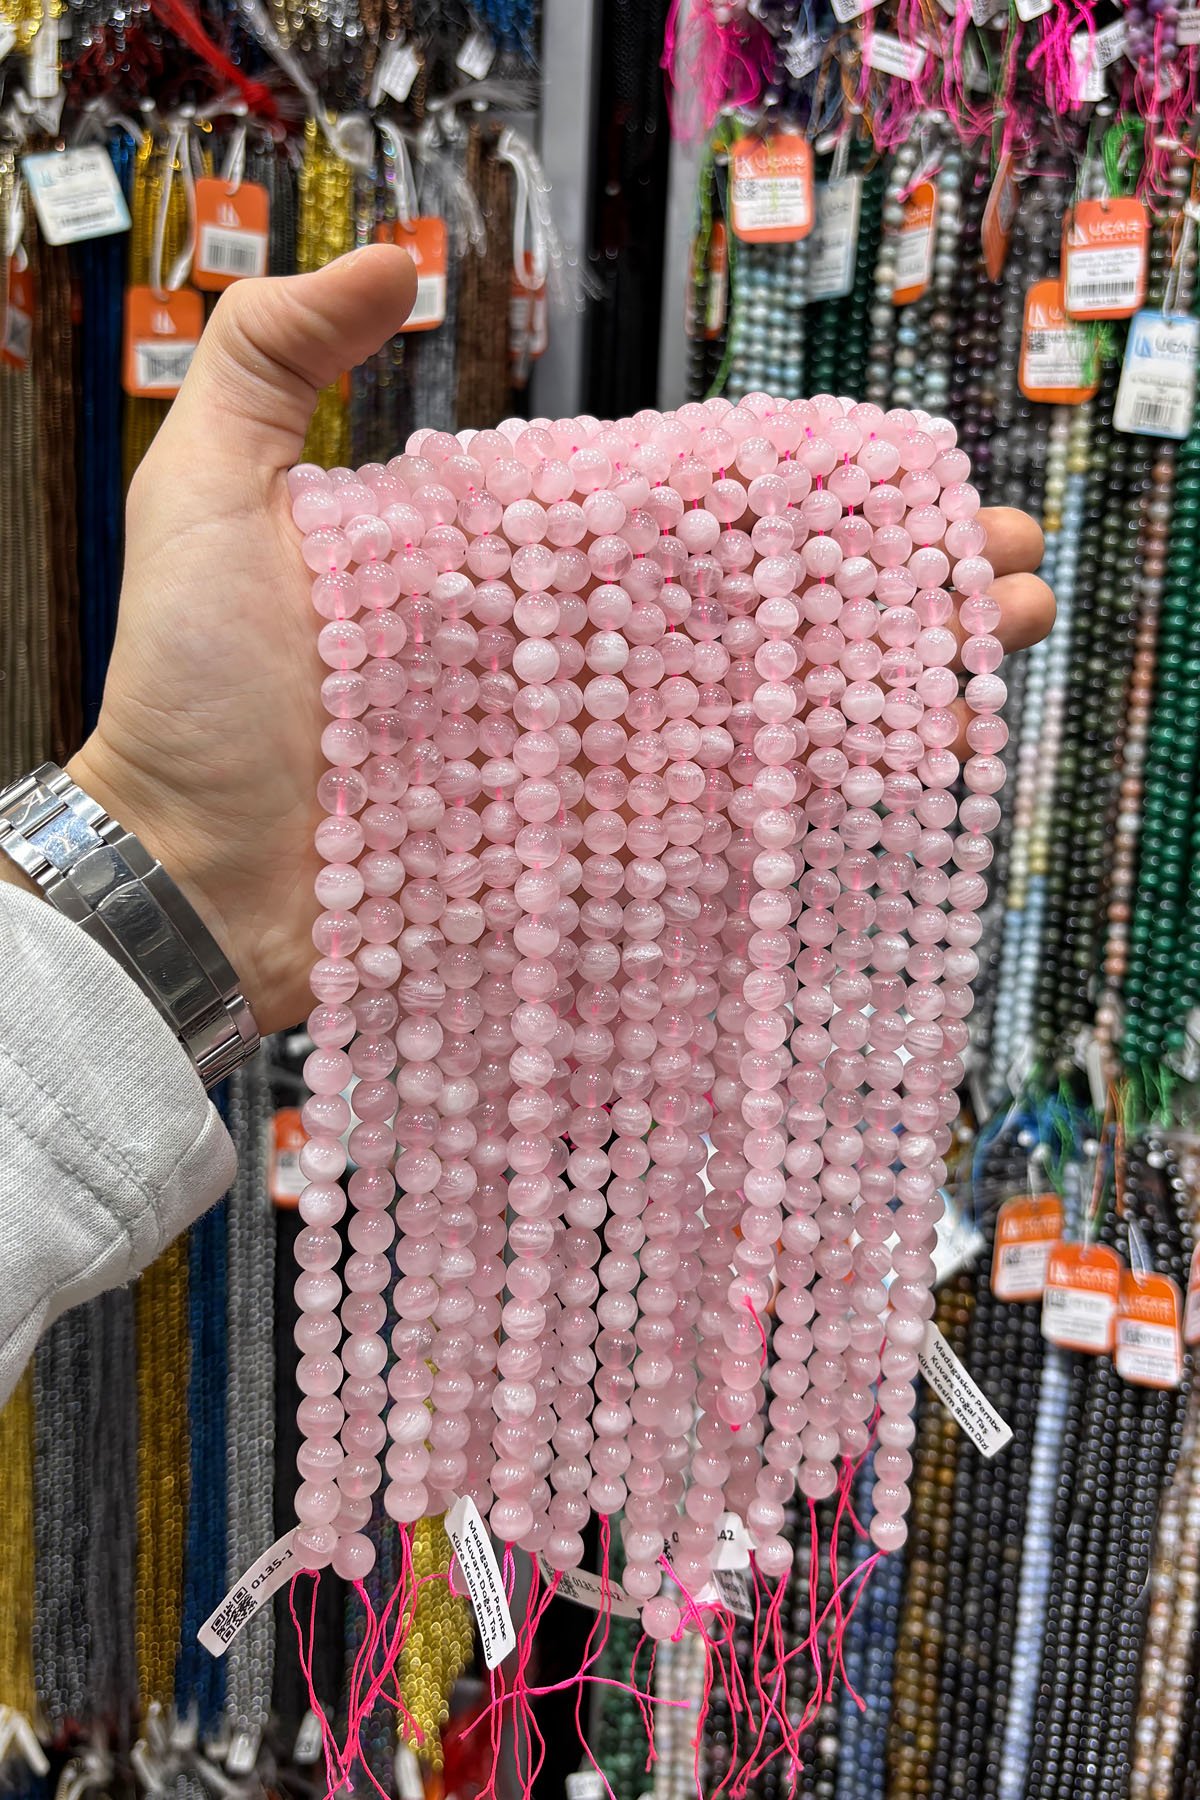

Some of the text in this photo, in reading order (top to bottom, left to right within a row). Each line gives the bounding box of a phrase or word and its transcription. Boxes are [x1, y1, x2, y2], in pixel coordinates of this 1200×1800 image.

[930, 1355, 955, 1389] Kuvars
[954, 1388, 977, 1417] Doğal
[933, 1341, 1001, 1433] Madagaskar Pembe
[251, 1549, 293, 1590] 0135-1
[451, 1531, 465, 1560] Küre
[464, 1536, 482, 1579] Kuvars
[479, 1581, 494, 1617] Doğal
[468, 1519, 507, 1641] Madagaskar Pembe
